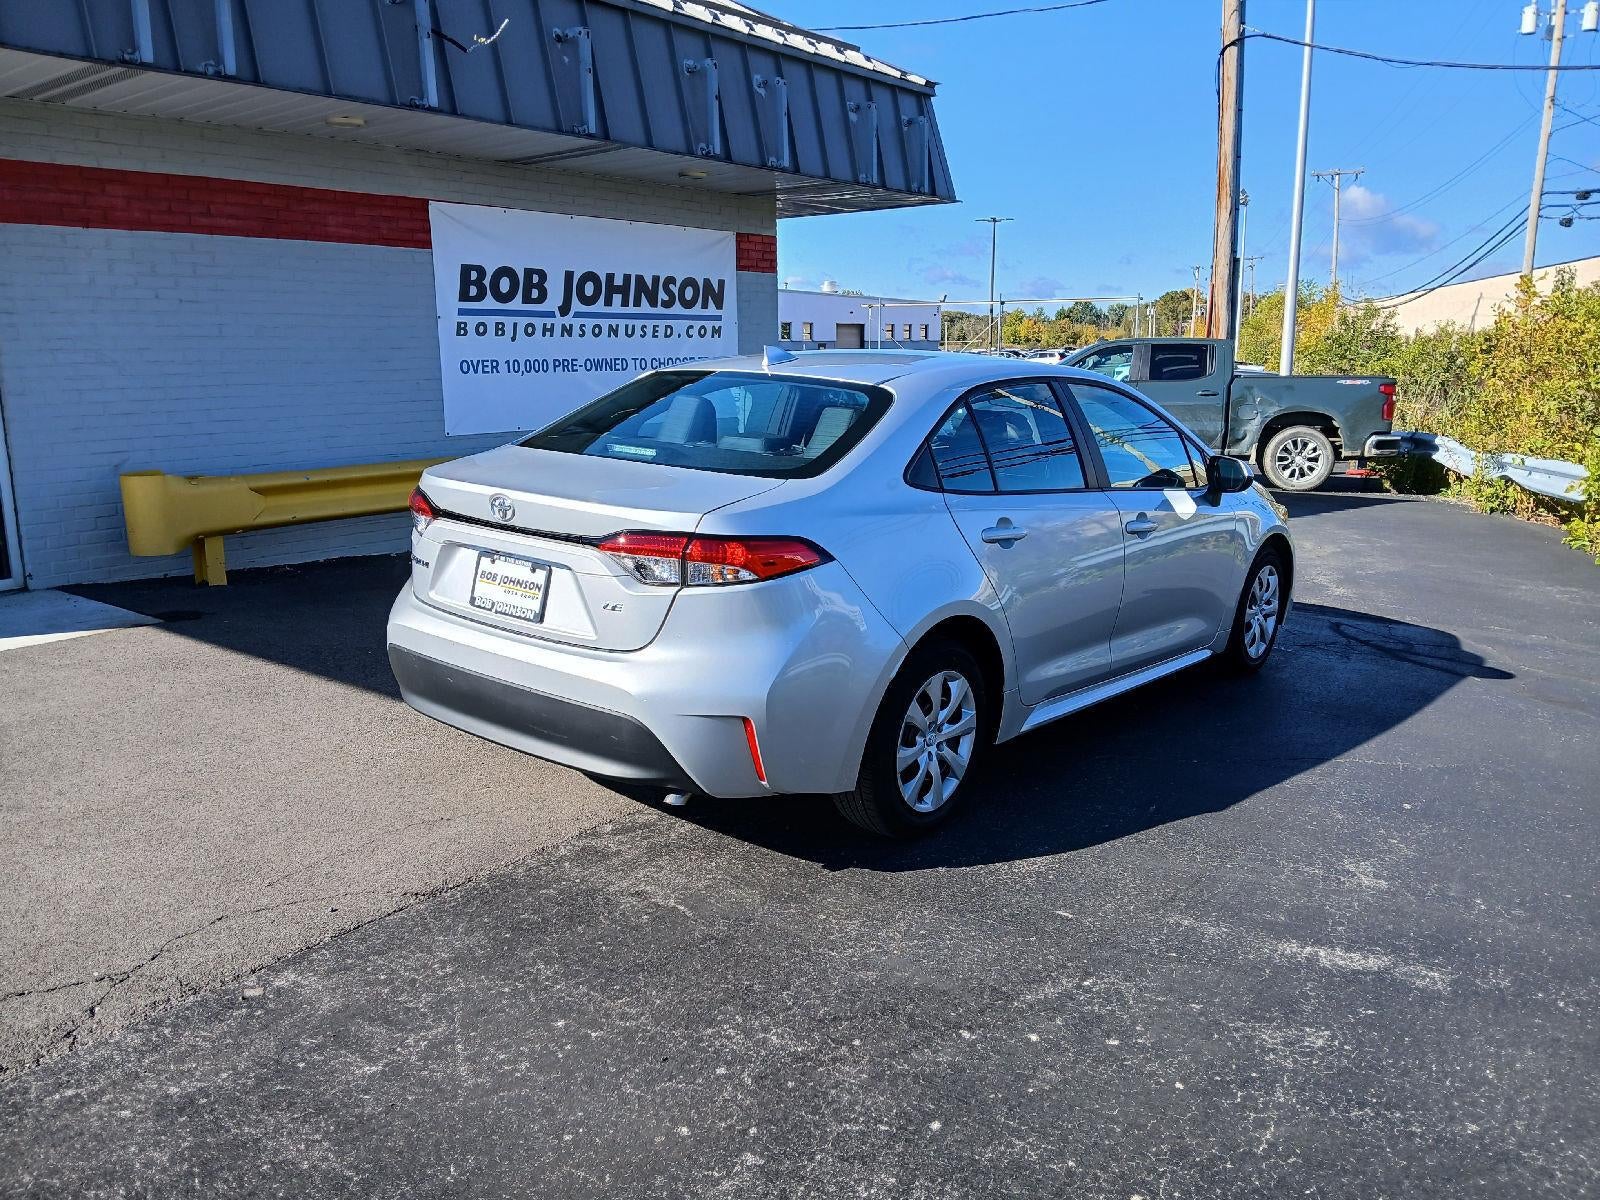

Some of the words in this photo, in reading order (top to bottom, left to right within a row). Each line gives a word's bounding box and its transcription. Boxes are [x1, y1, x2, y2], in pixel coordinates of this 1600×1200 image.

[458, 264, 548, 304] BOB
[558, 270, 725, 317] JOHNSON
[456, 321, 723, 342] BOBJOHNSONUSED.COM
[459, 359, 500, 375] OVER
[504, 358, 549, 376] 10,000
[553, 357, 628, 373] PRE-OWNED
[631, 357, 647, 371] TO
[651, 357, 696, 370] CHOO
[480, 570, 498, 582] BOB
[498, 574, 543, 593] JOHNSON
[474, 596, 494, 609] BOB
[492, 600, 536, 619] JOHNSON
